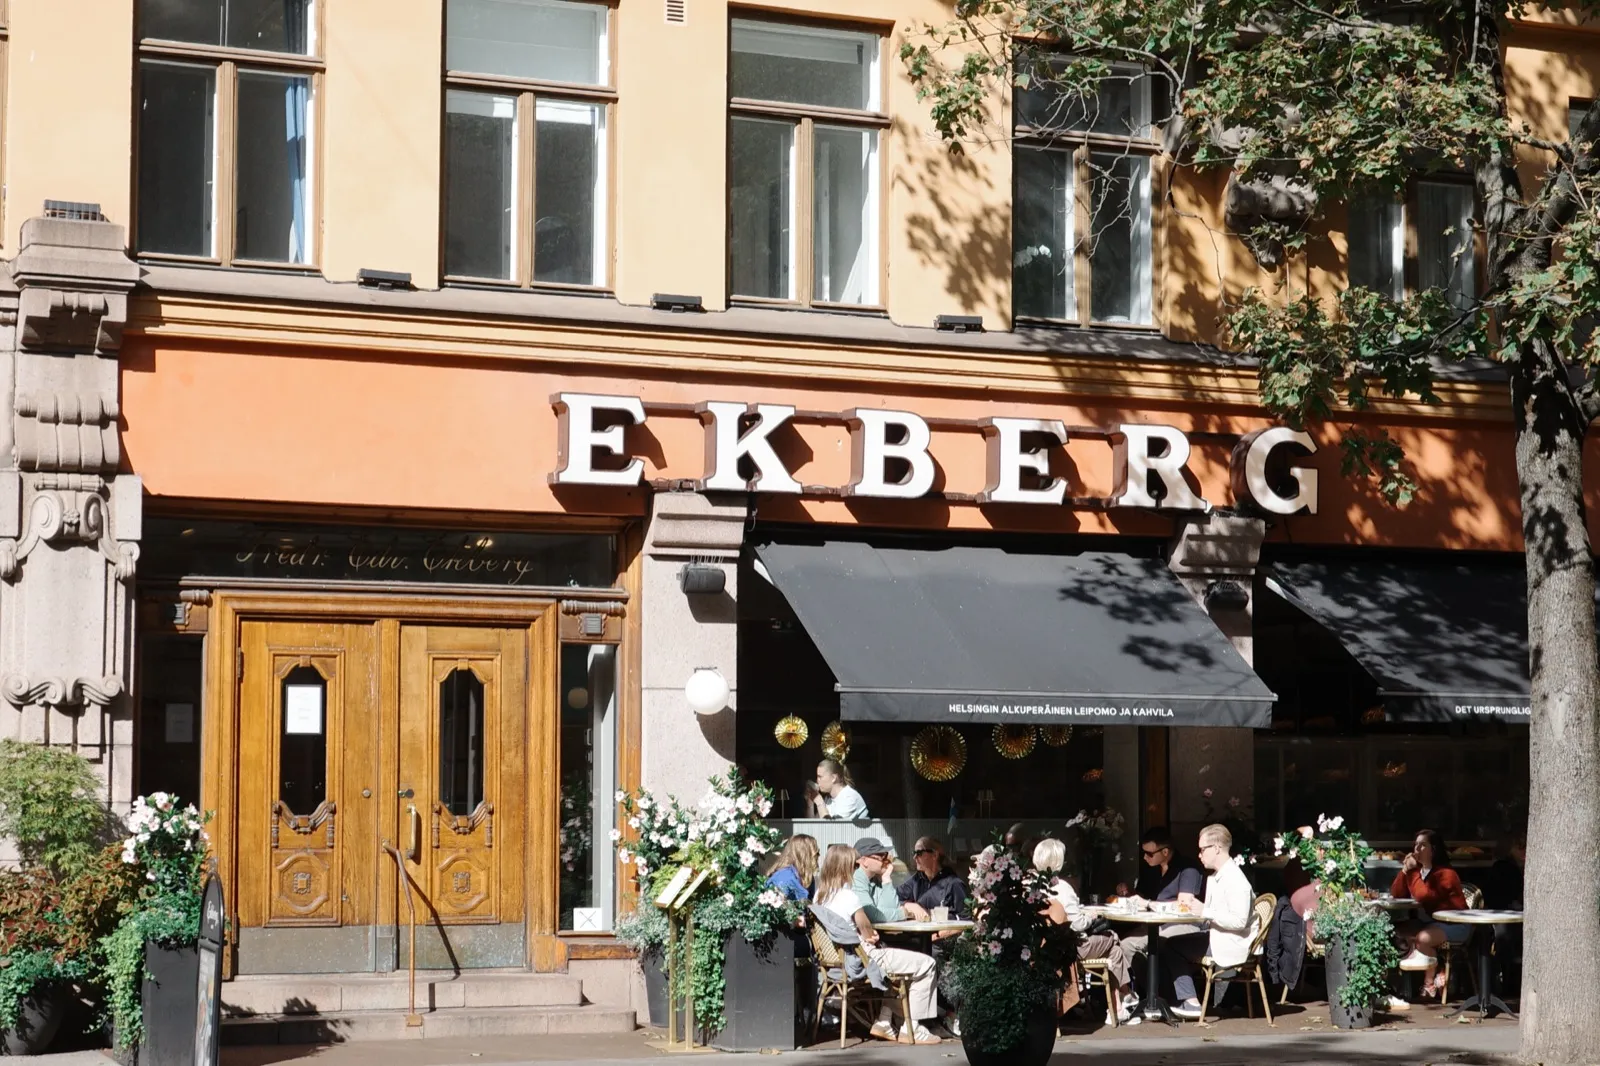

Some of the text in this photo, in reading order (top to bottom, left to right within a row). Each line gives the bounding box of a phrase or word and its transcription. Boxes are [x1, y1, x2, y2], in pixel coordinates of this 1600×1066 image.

[549, 392, 1319, 515] EKBERG
[949, 704, 1174, 717] HELSINGIN ALKUPERÄINEN LEIPOMO JA KAHVILA
[1455, 705, 1472, 713] DET
